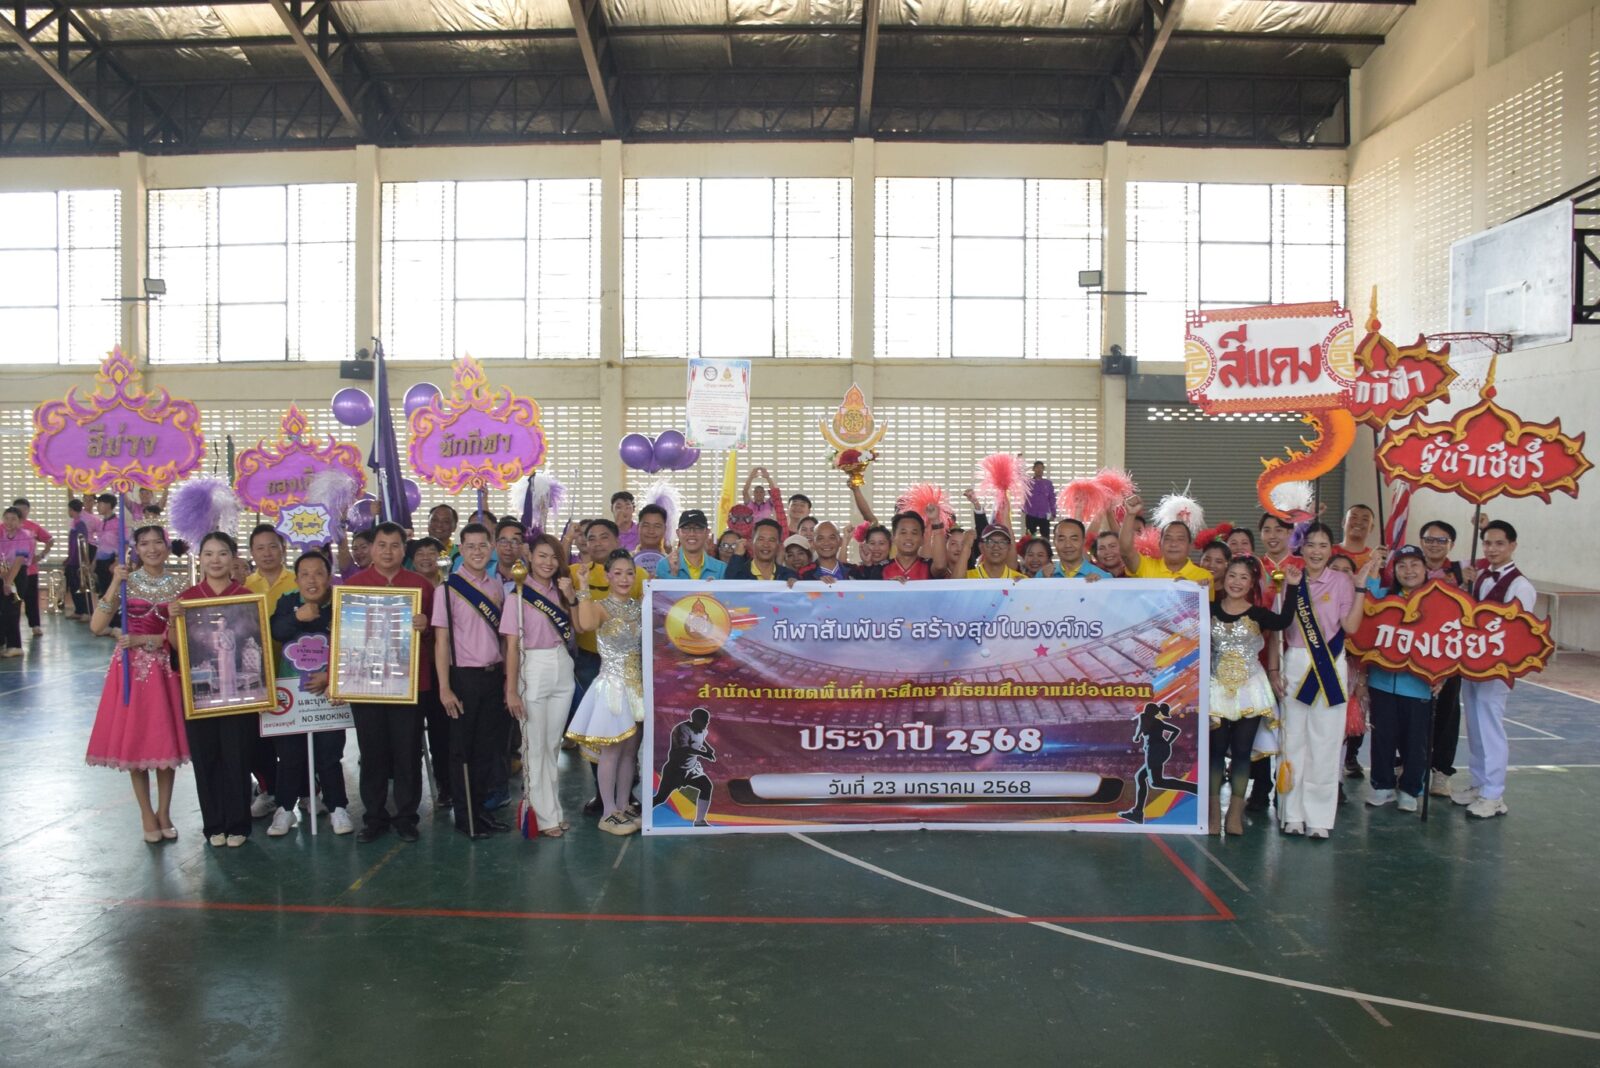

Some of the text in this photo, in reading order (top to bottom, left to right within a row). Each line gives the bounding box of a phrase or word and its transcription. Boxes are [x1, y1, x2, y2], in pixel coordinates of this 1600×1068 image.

[86, 422, 159, 458] สีม่วง
[439, 428, 512, 458] นักกีฬา
[1420, 436, 1545, 479] ผู้นำเชียร์
[772, 616, 1103, 645] กีฬาสัมพันธ์ สร้างสุขในองค์กร
[1374, 617, 1507, 659] กองเชียร์
[698, 680, 1151, 700] สำนักงานเขตพื้นที่การศึกษามัธยมศึกษาแม่ฮ่องสอน
[301, 712, 351, 723] NO SMOKING
[799, 721, 1042, 755] ประจำปี 2568
[828, 775, 1032, 795] วันที่ 23 มกราคม 2568
